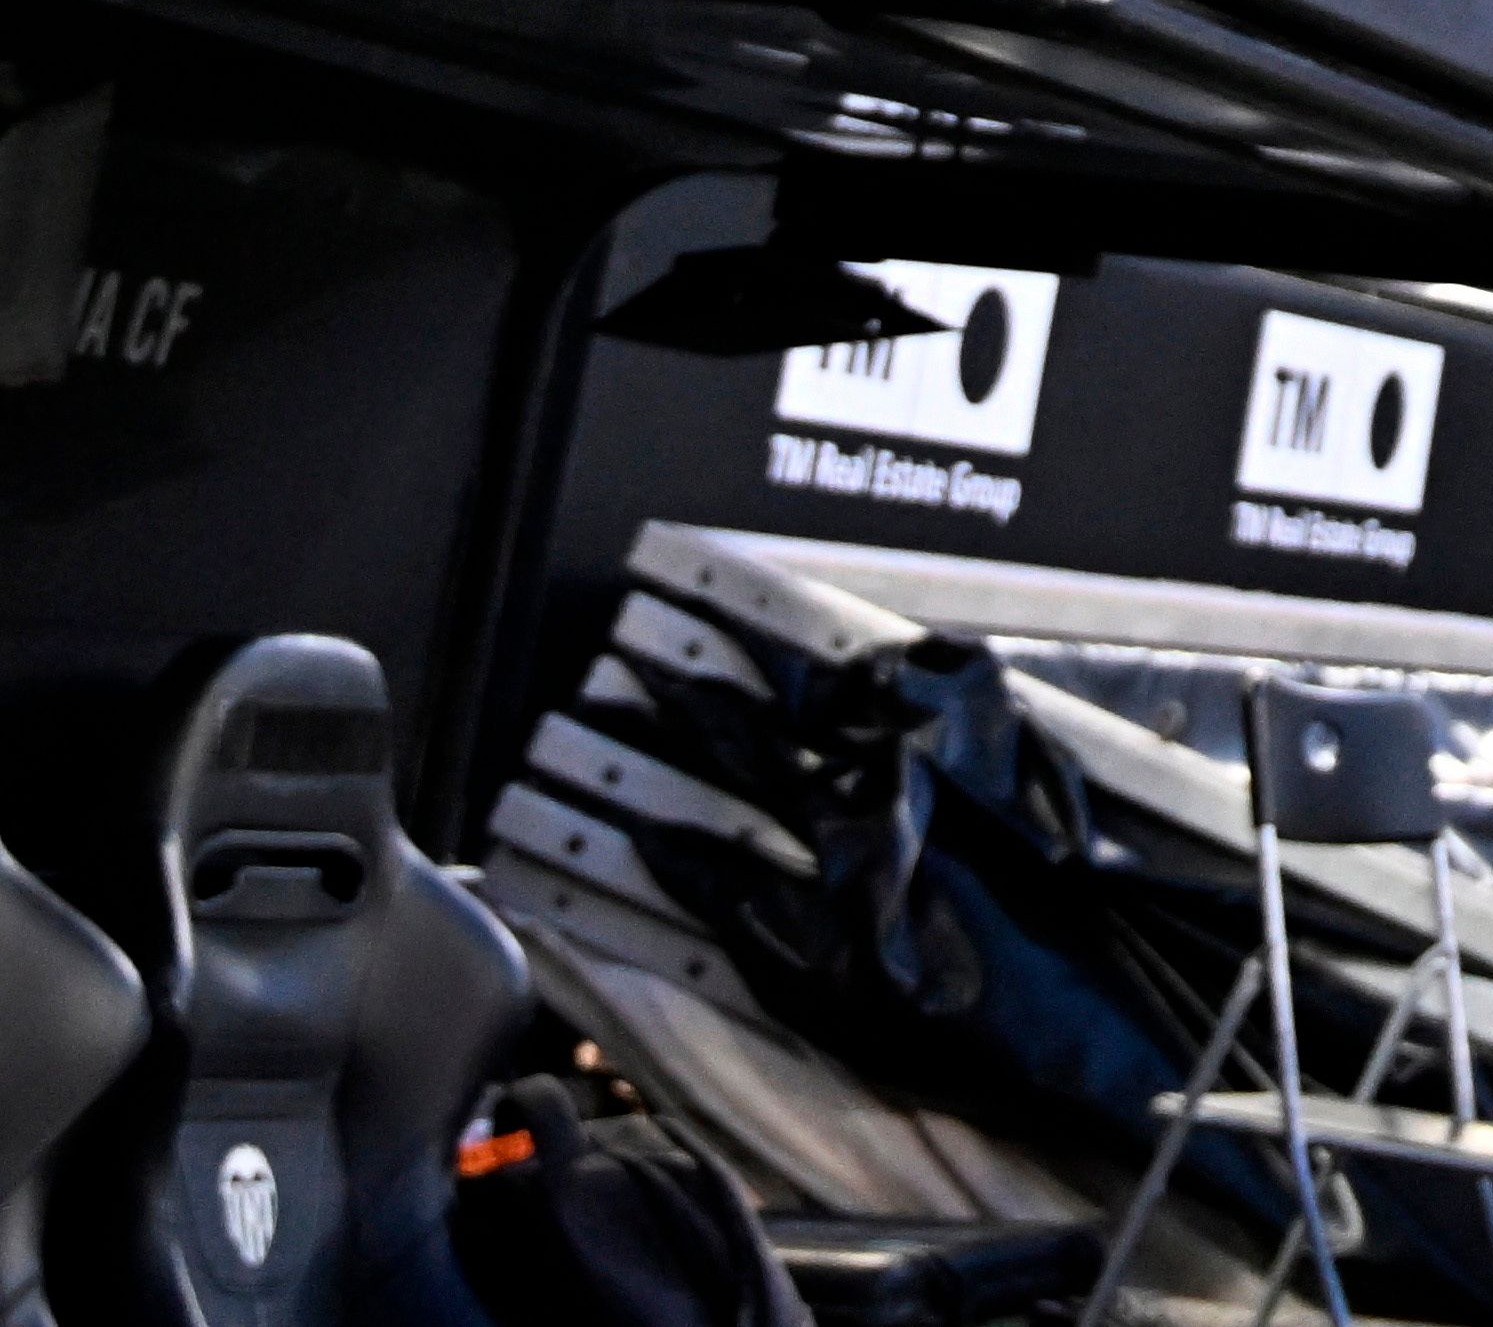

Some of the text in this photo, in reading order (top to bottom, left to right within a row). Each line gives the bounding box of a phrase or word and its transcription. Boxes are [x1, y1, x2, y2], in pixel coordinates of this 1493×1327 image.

[122, 276, 206, 367] CF
[1270, 366, 1331, 453] TM
[766, 432, 1022, 526] TM Real Estate Group
